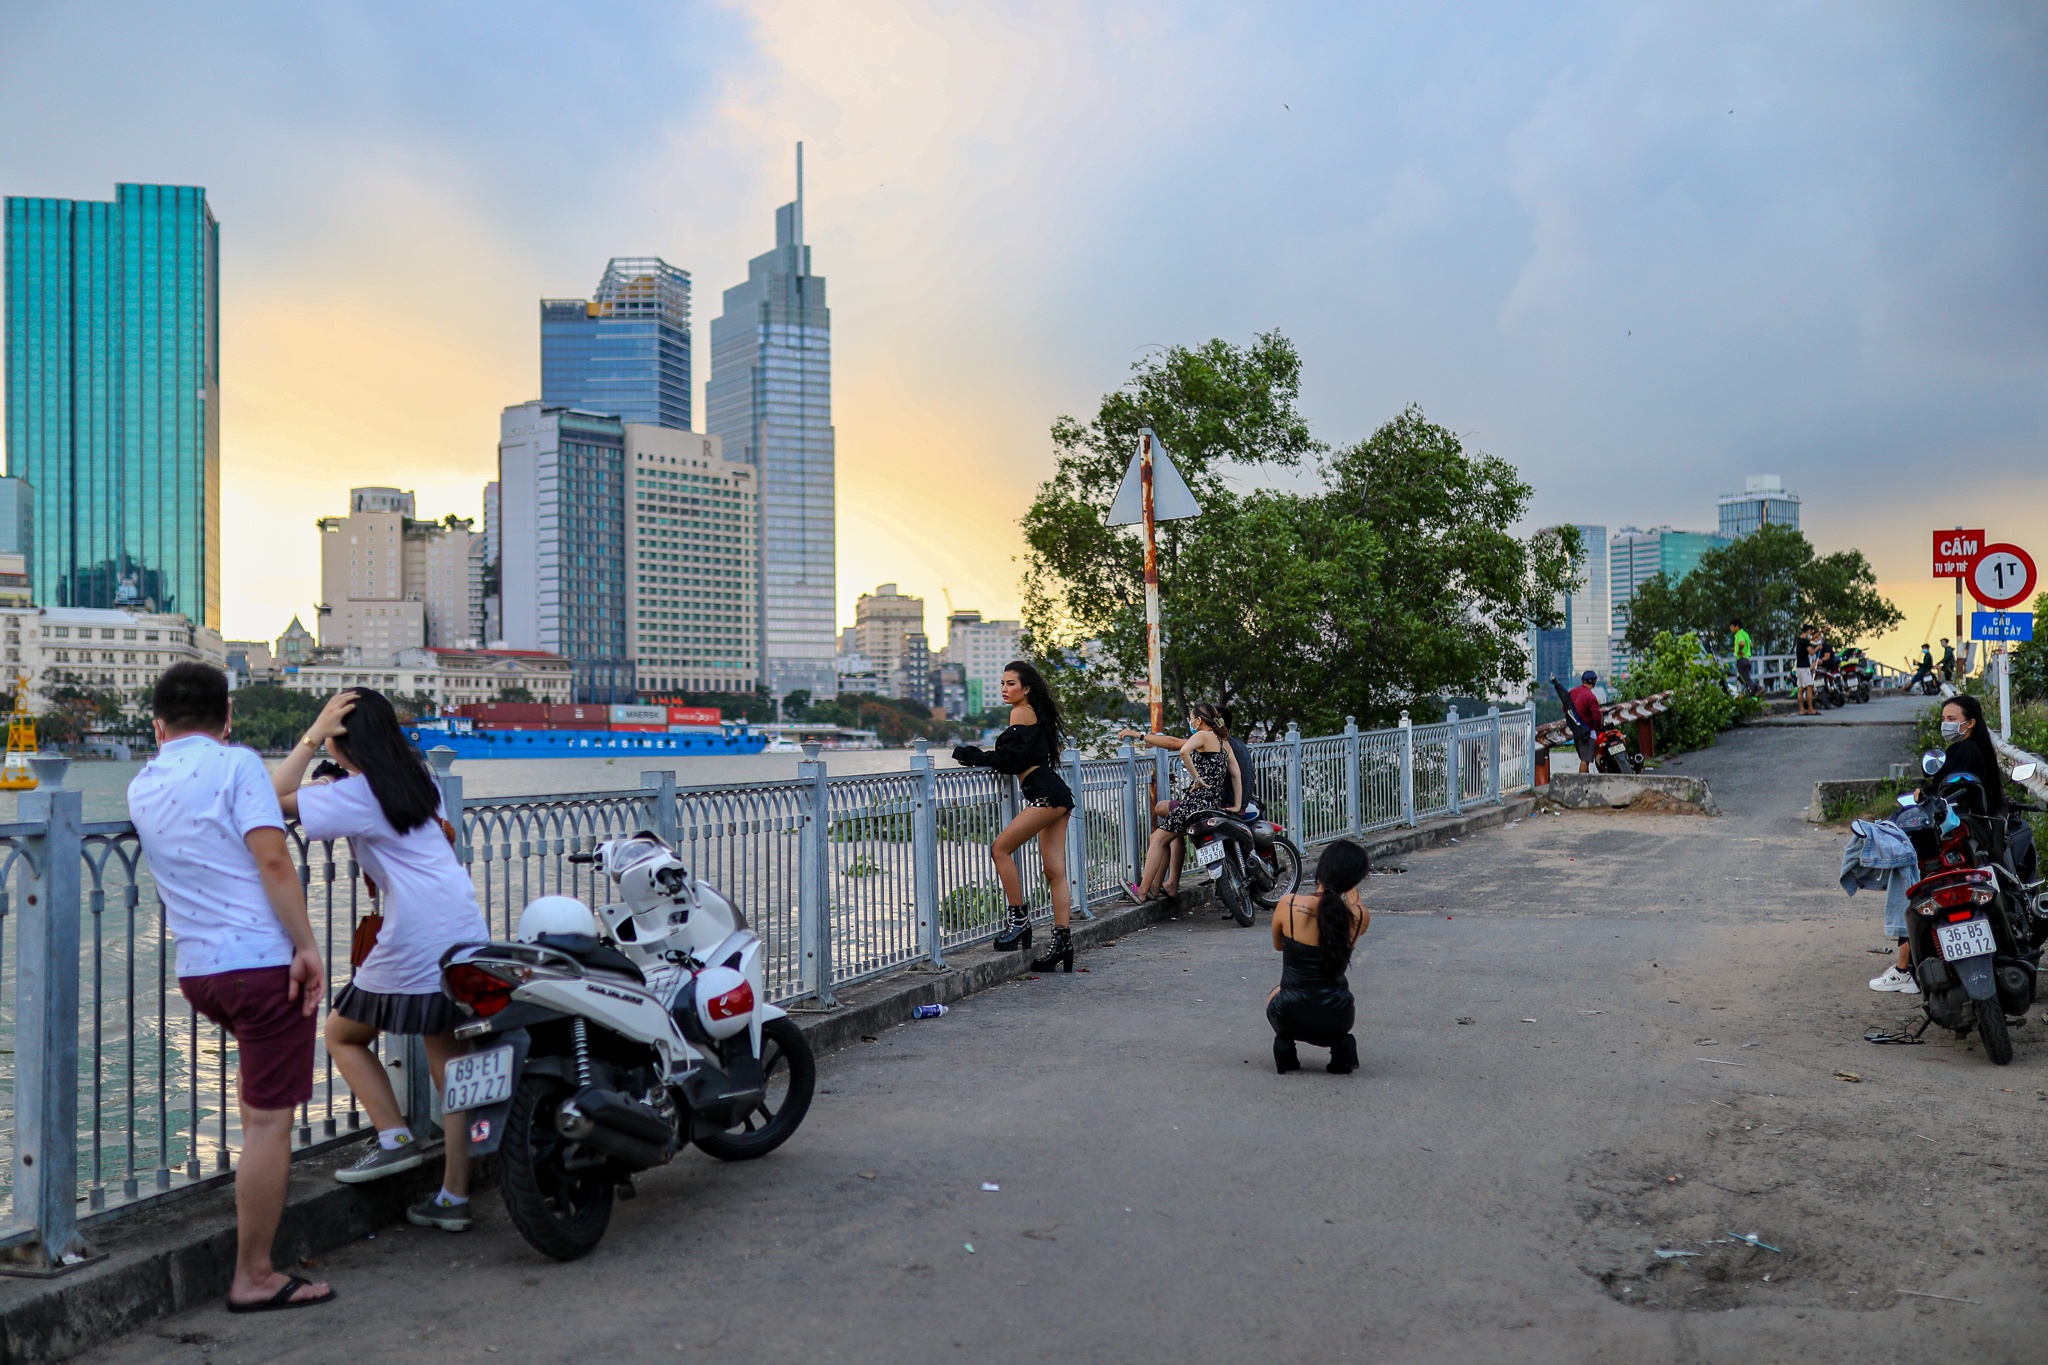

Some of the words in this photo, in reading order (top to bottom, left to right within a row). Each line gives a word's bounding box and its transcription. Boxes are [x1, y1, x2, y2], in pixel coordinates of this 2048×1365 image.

[702, 440, 714, 457] R
[626, 711, 659, 719] MAERSK
[568, 739, 677, 749] TRANSIMEX
[1946, 923, 1983, 943] 36-B5
[1946, 937, 1992, 958] 889.12
[447, 1075, 505, 1109] 037.27
